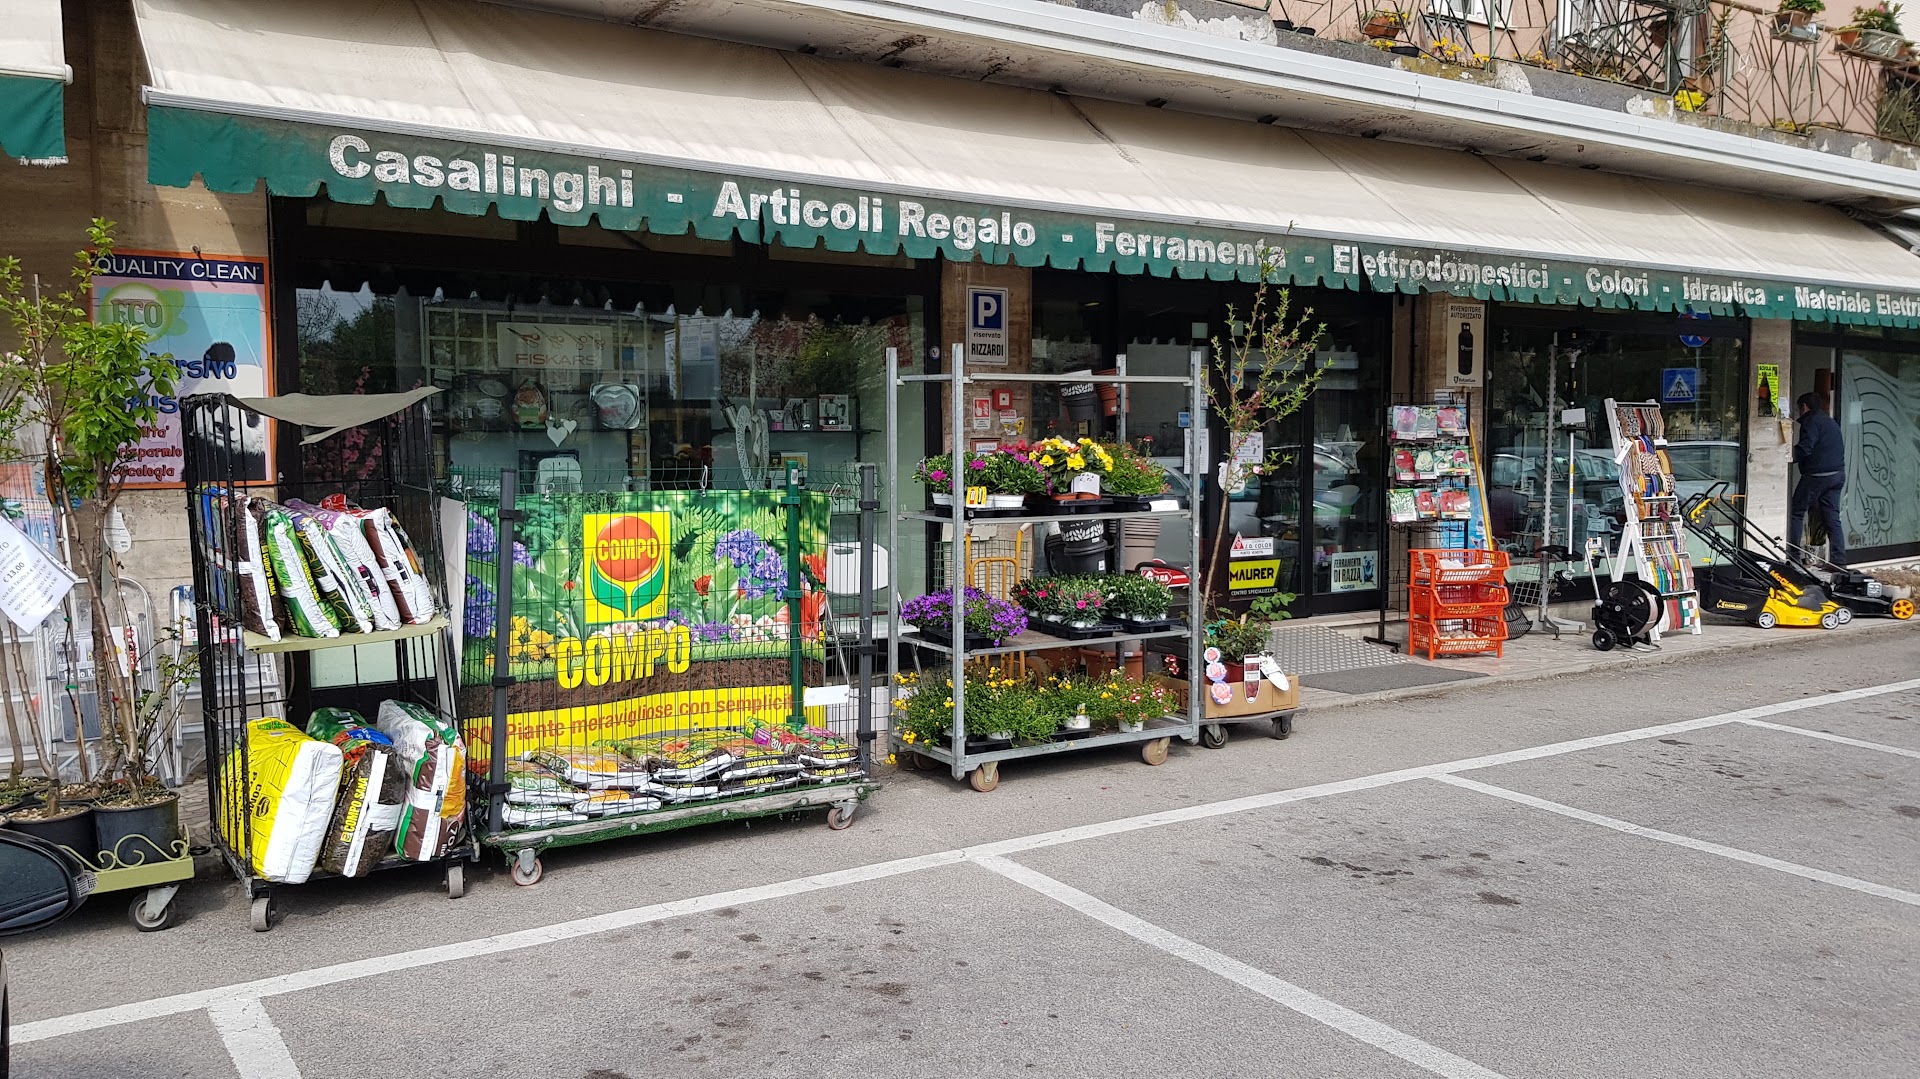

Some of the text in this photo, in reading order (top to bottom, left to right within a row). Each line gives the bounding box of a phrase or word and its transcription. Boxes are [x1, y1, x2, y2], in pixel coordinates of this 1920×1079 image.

[328, 134, 634, 212] Casalinghi
[712, 181, 882, 233] Articoli
[898, 200, 1036, 250] Regalo
[1096, 222, 1286, 268] Ferramenta
[1332, 244, 1548, 289] Elettrodomestici
[1586, 268, 1649, 297] Colori
[1794, 286, 1871, 314] Materiale
[94, 257, 257, 280] QUALITY CLEAN
[111, 298, 162, 328] ECO
[978, 296, 998, 326] P
[1450, 312, 1482, 320] AUTORIZZATO
[516, 353, 597, 366] FISKARS
[972, 343, 1004, 356] RIZZARDI
[112, 464, 175, 481] cologia
[598, 537, 658, 561] COMPO
[6, 561, 26, 580] 13,00
[1334, 558, 1362, 568] FERRAMENTA
[1230, 568, 1274, 582] MAURER
[1334, 568, 1361, 582] DI RAZZA
[557, 625, 691, 689] COMPO
[506, 719, 564, 741] Piante
[572, 704, 673, 734] meravigliose
[680, 700, 710, 715] con
[716, 693, 794, 714] semplicit
[344, 776, 368, 832] COMPO SANA
